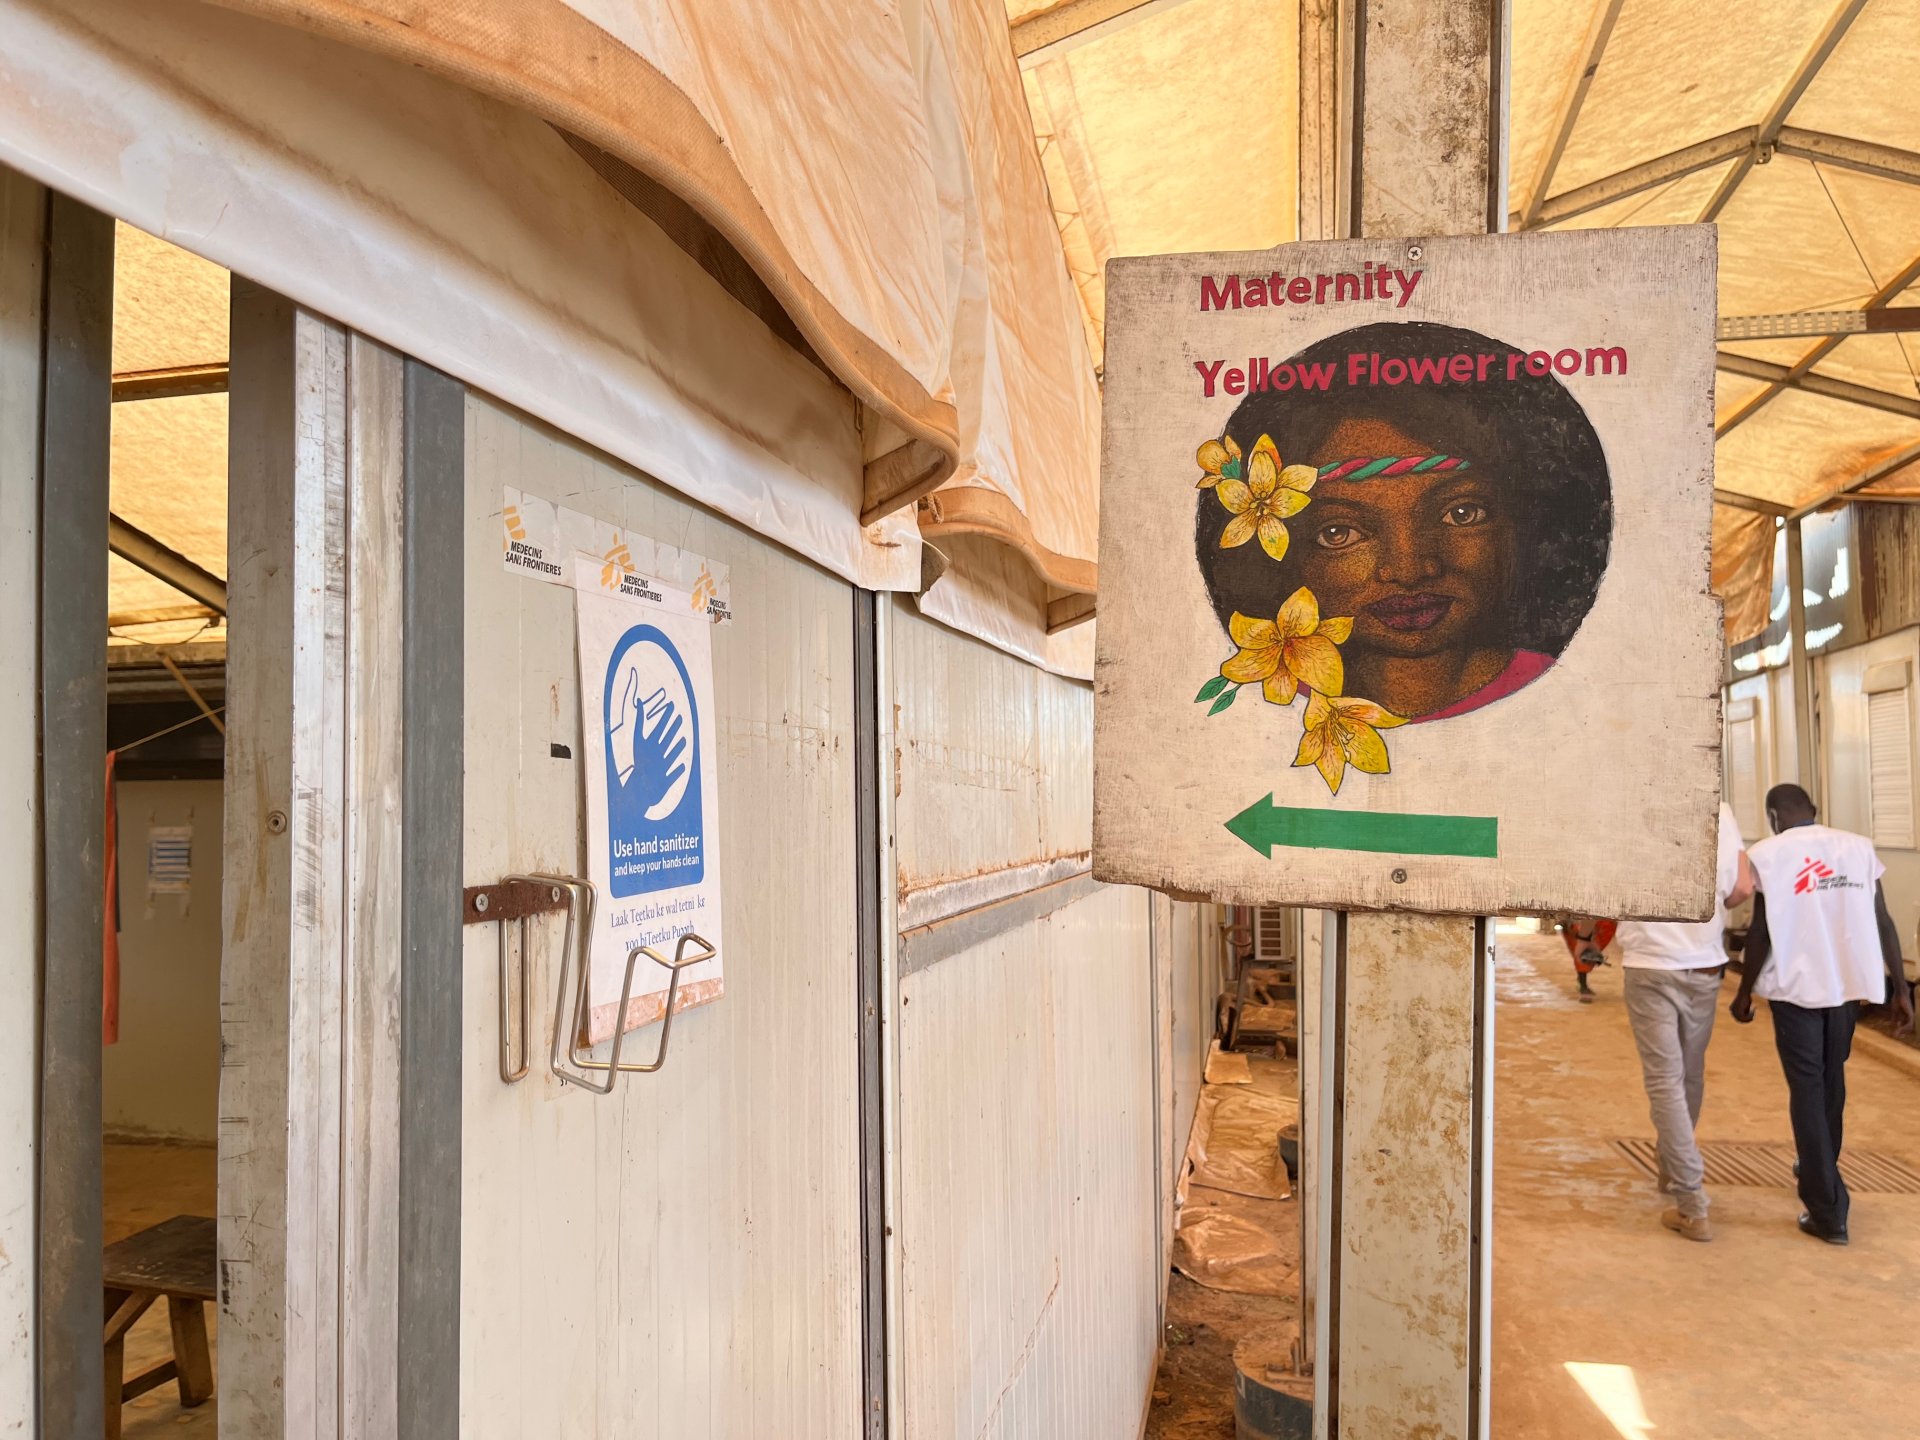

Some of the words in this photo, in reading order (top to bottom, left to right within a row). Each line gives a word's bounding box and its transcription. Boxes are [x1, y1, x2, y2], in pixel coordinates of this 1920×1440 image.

[1200, 261, 1423, 311] Maternity
[1194, 357, 1337, 397] Yellow
[1347, 352, 1495, 386] Flower
[1507, 346, 1627, 382] room
[511, 541, 542, 559] MEDECINS
[506, 552, 522, 566] SANS
[523, 557, 561, 576] FRONTIERES
[620, 584, 633, 595] SANS
[634, 587, 662, 602] FRONTIERES
[624, 574, 649, 589] MEDECINS
[613, 839, 633, 858] Use
[634, 836, 658, 856] hand
[660, 832, 699, 852] sanitizer
[614, 862, 628, 877] and
[629, 862, 645, 875] keep
[646, 861, 661, 874] your
[662, 857, 681, 869] hands
[682, 854, 700, 866] clean
[611, 909, 629, 928] Laak
[665, 898, 677, 914] wal
